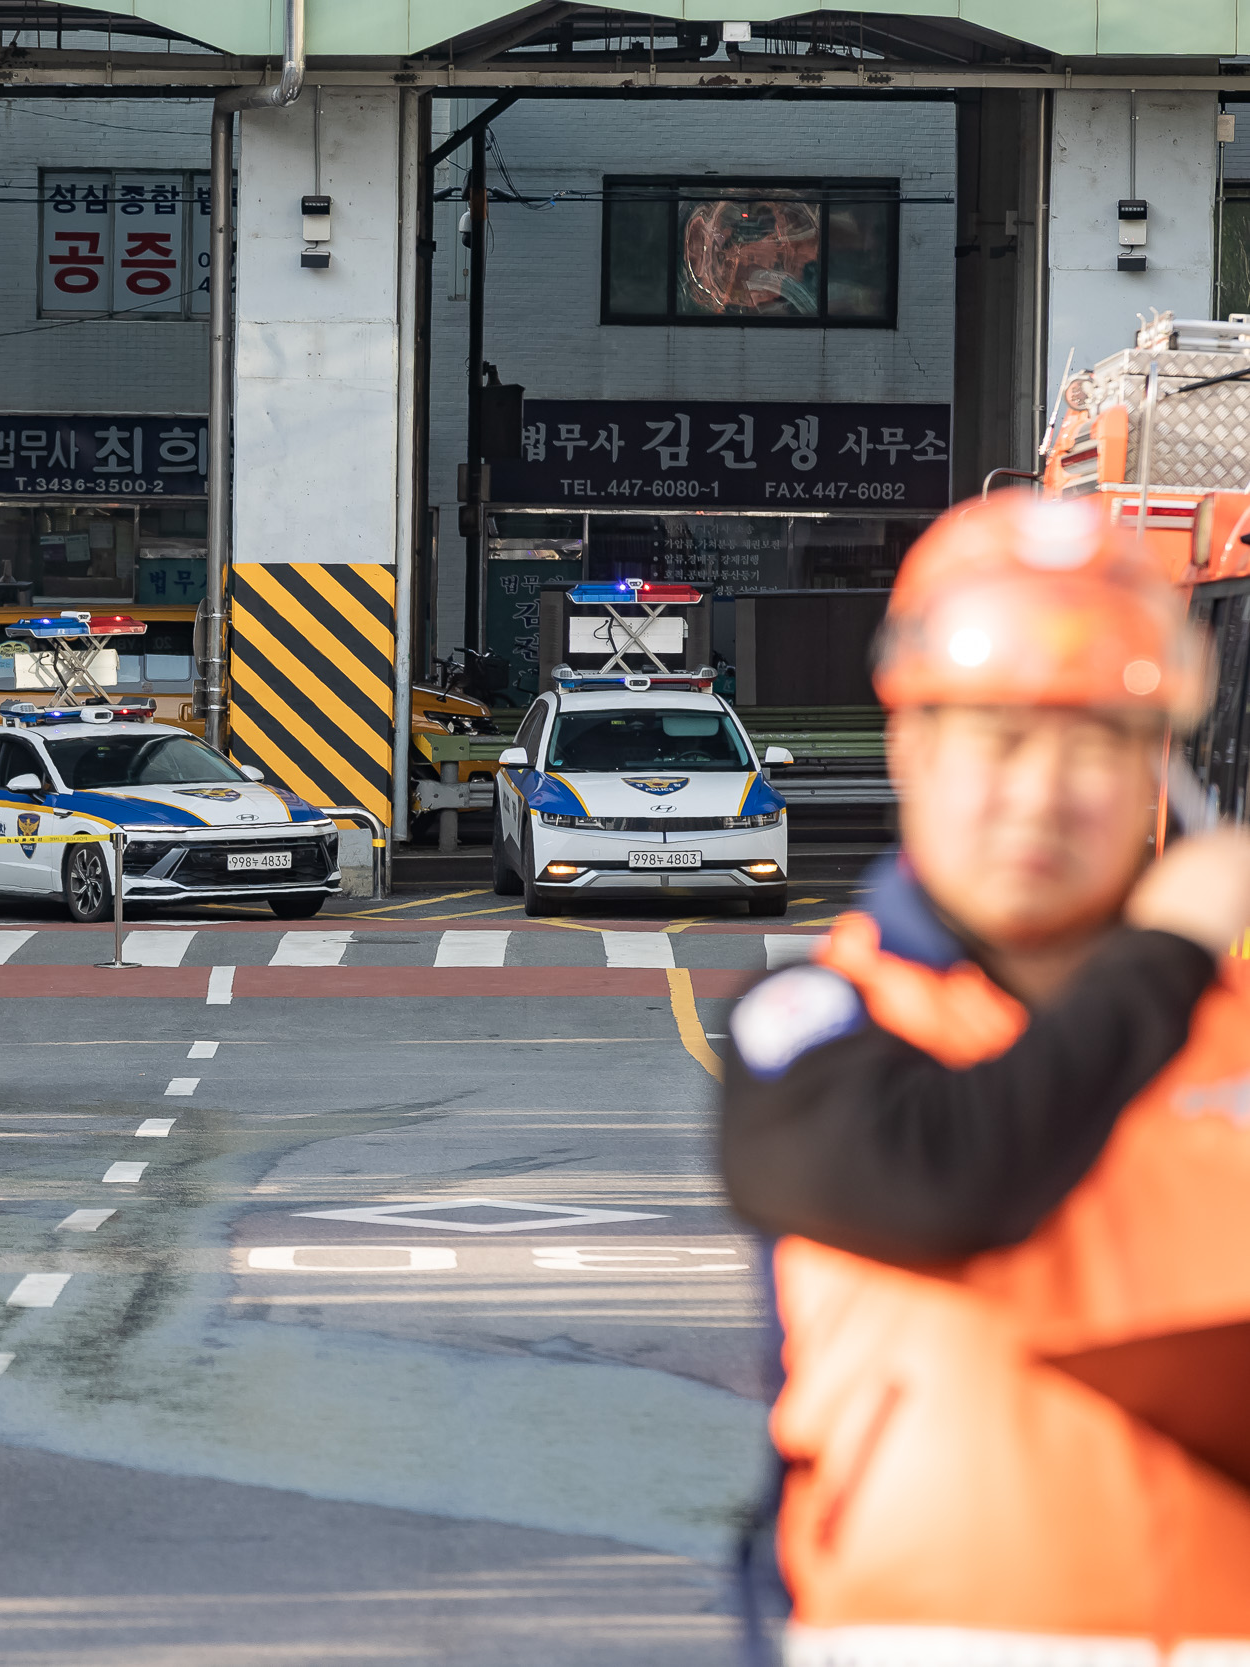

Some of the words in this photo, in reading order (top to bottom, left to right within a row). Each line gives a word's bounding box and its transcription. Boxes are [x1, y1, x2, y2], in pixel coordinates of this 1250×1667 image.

[48, 231, 177, 295] 공증
[93, 425, 210, 476] 최희
[522, 422, 625, 464] 법무사
[641, 413, 820, 471] 김건생
[838, 425, 949, 466] 사무소
[765, 482, 906, 500] FAX.447-6082
[149, 569, 207, 595] 법무
[231, 856, 259, 868] 998누
[261, 855, 288, 867] 4833
[633, 853, 664, 866] 998누
[666, 853, 697, 865] 4803
